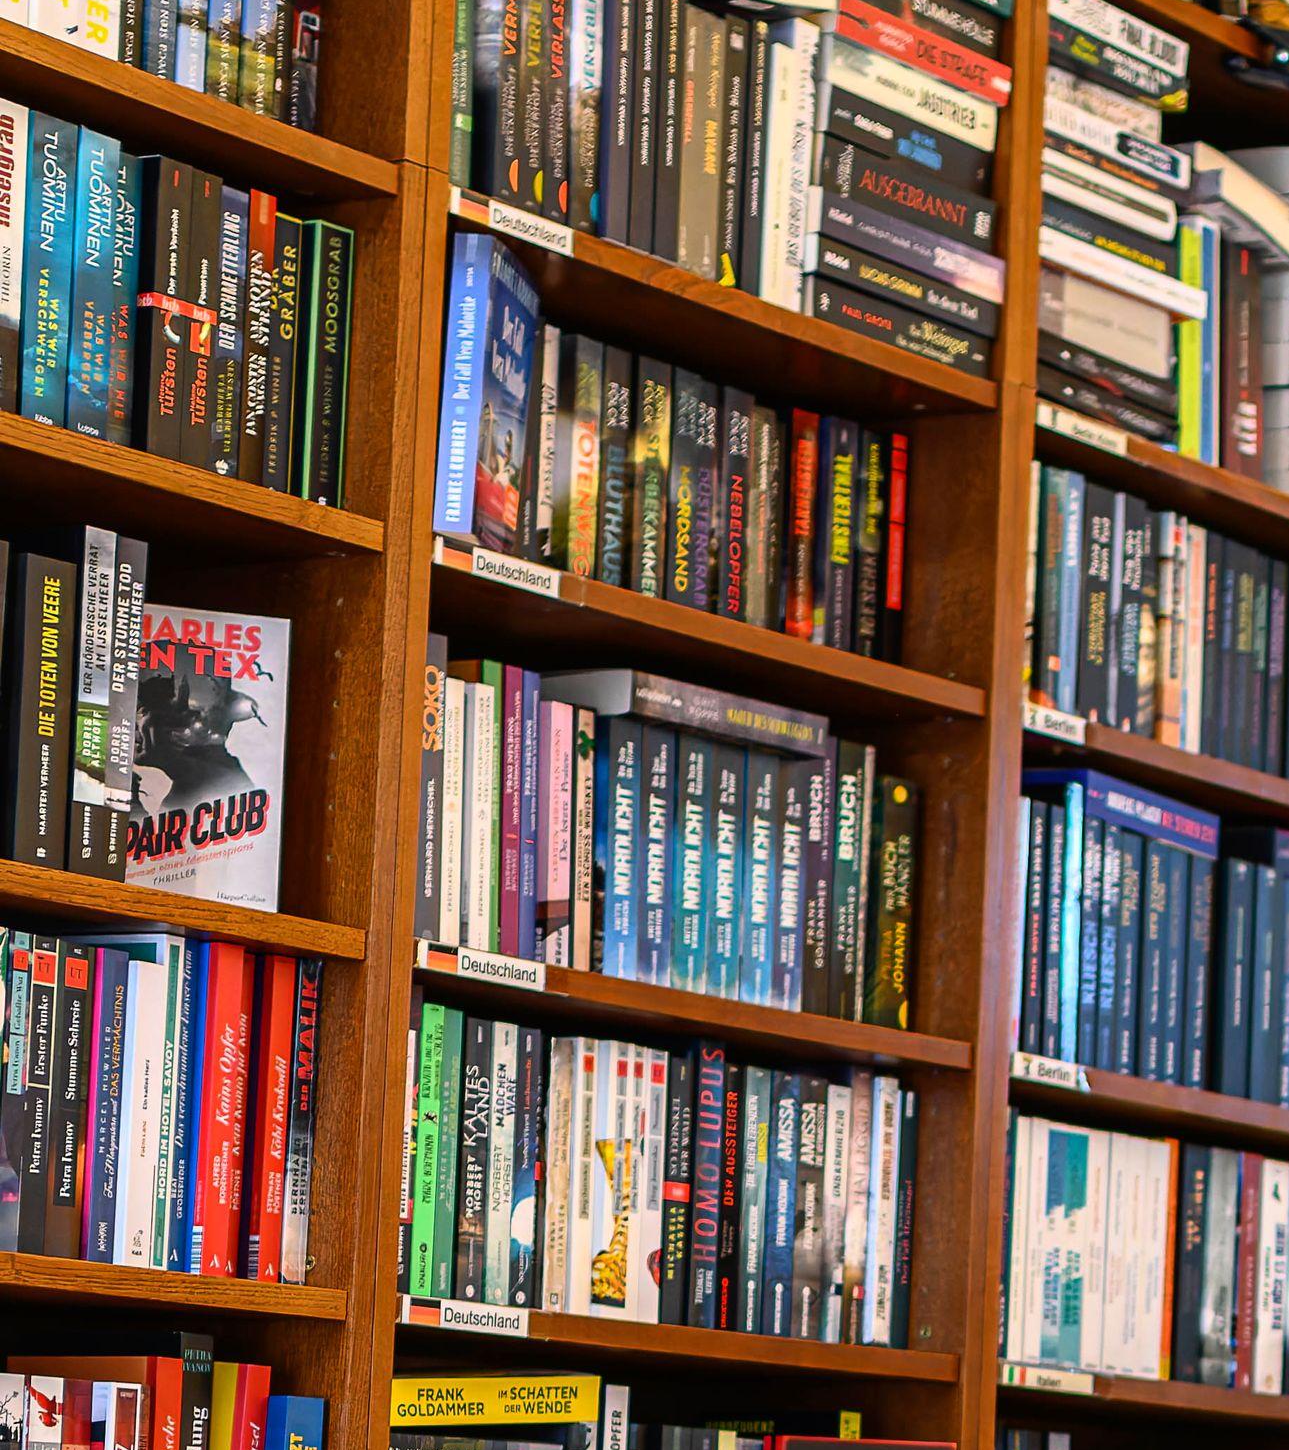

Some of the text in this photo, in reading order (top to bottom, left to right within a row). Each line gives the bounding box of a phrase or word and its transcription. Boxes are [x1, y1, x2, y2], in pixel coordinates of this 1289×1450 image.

[39, 132, 60, 252] TUOMINEN
[53, 163, 67, 221] ARTTU
[219, 212, 241, 350] DER SCHMETTERLING
[476, 556, 552, 589] Deutschland
[39, 576, 61, 738] DIE TOTEN VON VEERE
[112, 563, 132, 693] DER STUMME TOD
[190, 789, 270, 848] CLUB
[462, 956, 537, 983] Deutschland
[60, 999, 80, 1199] Petra Ivanov Stumme Schreie
[157, 1040, 173, 1199] MORD IM HOTEL SAVOY
[444, 1308, 520, 1330] Deutschland
[397, 1402, 485, 1418] GOLDAMMER
[416, 1388, 464, 1402] FRANK
[498, 1385, 578, 1400] IM SCHATTEN
[505, 1399, 572, 1414] DER WENDE
